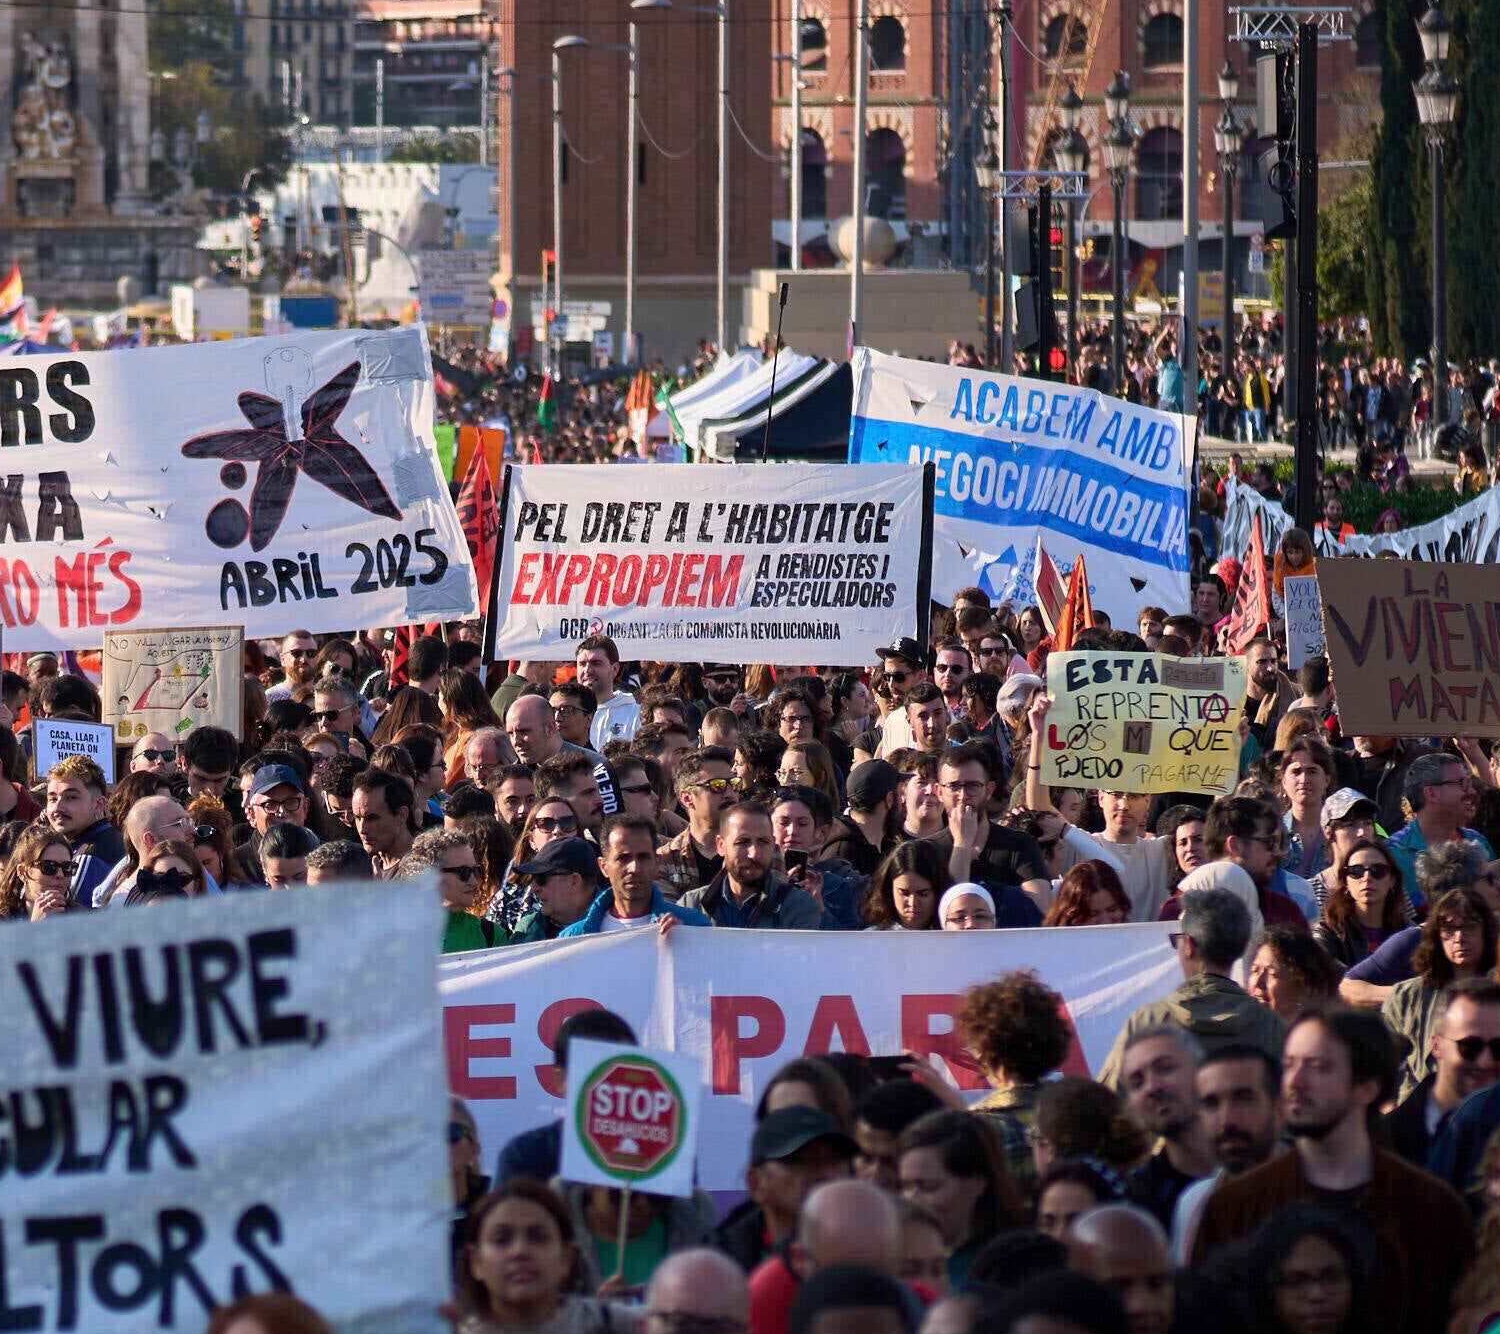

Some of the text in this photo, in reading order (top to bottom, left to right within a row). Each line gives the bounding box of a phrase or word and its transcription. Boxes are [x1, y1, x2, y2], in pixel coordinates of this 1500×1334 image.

[949, 377, 1177, 472] ACABEM AMB
[514, 501, 568, 543] PEL
[580, 501, 661, 544] DRET
[665, 501, 690, 543] A
[697, 501, 896, 544] L'HABITATGE
[346, 528, 449, 595] 2025
[754, 552, 890, 580] A RENDISTES I
[54, 536, 143, 628] MÉS
[509, 552, 746, 608] EXPROPIEM
[750, 581, 897, 608] ESPECULADORS
[1402, 567, 1449, 597] LA
[559, 617, 589, 640] OCR
[685, 620, 748, 640] COMUNISTA
[749, 617, 841, 641] REVOLUCIONÀRIA
[109, 638, 130, 652] NO
[1066, 658, 1159, 692] ESTA
[50, 729, 94, 743] CASA, LLAR
[51, 740, 99, 754] PLANETA ON
[1169, 725, 1233, 755] QUE
[1132, 764, 1235, 786] PAGARME
[598, 784, 618, 815] QUE
[16, 926, 328, 1069] VIURE,
[592, 1081, 672, 1124] STOP
[593, 1117, 669, 1144] DESAHUCIOS
